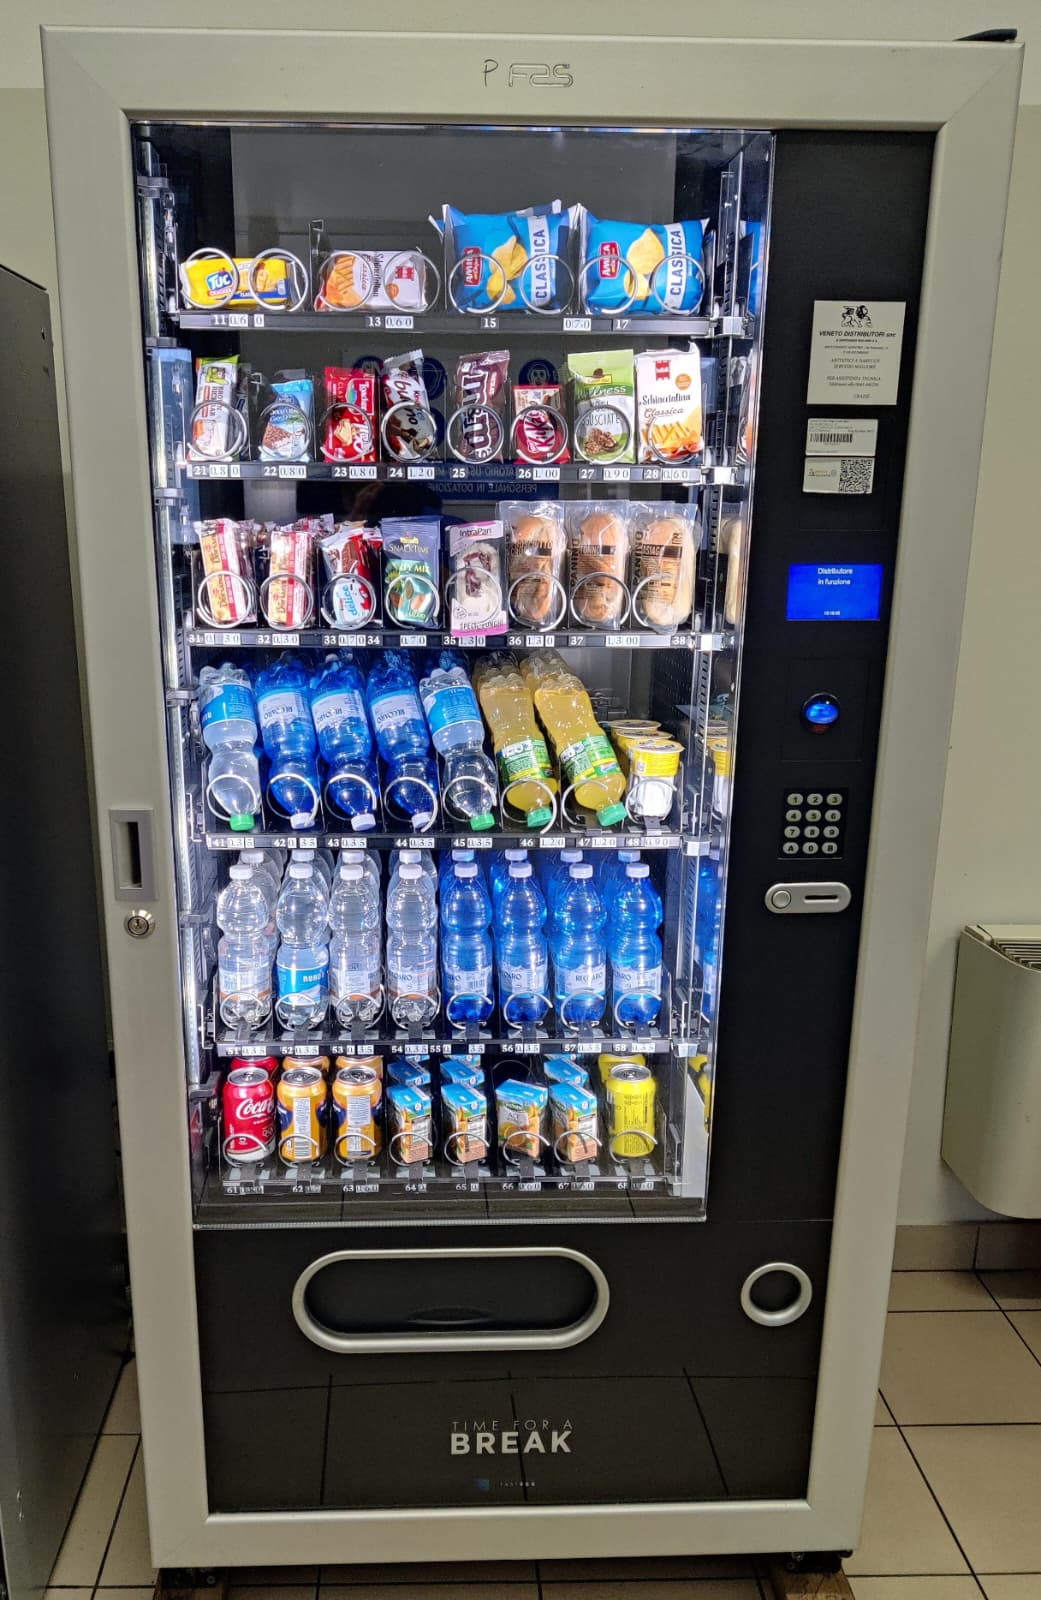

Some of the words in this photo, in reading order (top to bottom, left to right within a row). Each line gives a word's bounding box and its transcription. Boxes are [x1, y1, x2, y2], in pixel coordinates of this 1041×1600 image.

[533, 229, 547, 299] CLASSICA
[669, 230, 683, 296] CLASSICA
[208, 273, 231, 290] TUC
[213, 314, 227, 326] 11
[368, 316, 382, 327] 13
[483, 317, 497, 328] 15
[615, 319, 629, 330] 17
[263, 466, 278, 477] 22
[334, 467, 347, 478] 23
[389, 467, 403, 478] 24
[452, 468, 466, 478] 25
[518, 468, 532, 479] 26
[581, 468, 594, 479] 27
[644, 468, 658, 479] 28
[323, 635, 337, 645] 33
[367, 635, 381, 645] 34
[443, 635, 457, 646] 35
[508, 635, 522, 646] 36
[570, 636, 584, 646] 37
[671, 635, 686, 646] 38
[273, 838, 286, 848] 42
[327, 838, 339, 848] 43
[395, 838, 409, 848] 44
[453, 838, 466, 848] 45
[520, 838, 534, 848] 46
[577, 838, 591, 848] 47
[331, 1045, 344, 1055] 53
[391, 1045, 404, 1054] 54
[429, 1045, 442, 1054] 55
[502, 1044, 514, 1054] 56
[564, 1044, 577, 1053] 57
[614, 1044, 627, 1053] 58
[292, 1185, 305, 1193] 62
[342, 1184, 355, 1193] 63
[404, 1183, 418, 1192] 64
[455, 1183, 468, 1192] 65
[502, 1182, 515, 1191] 66
[557, 1182, 570, 1191] 67
[451, 1420, 500, 1432] TIME
[513, 1419, 549, 1430] FOR
[562, 1418, 573, 1430] A
[450, 1430, 571, 1455] BREAK
